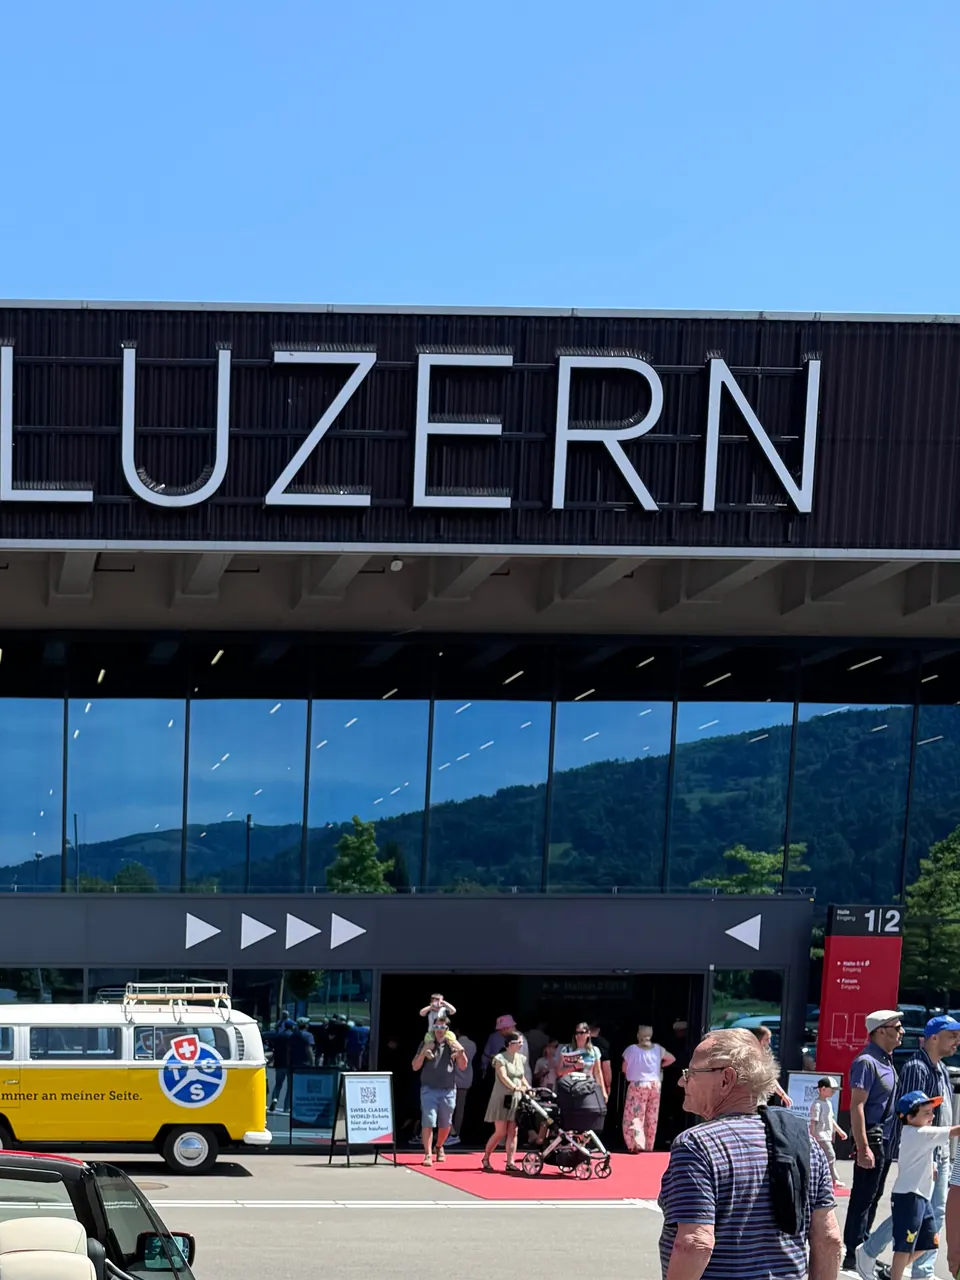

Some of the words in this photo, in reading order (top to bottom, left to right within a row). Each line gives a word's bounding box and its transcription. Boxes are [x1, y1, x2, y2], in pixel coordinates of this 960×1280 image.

[41, 1092, 58, 1101] an
[60, 1090, 106, 1101] meiner
[109, 1090, 143, 1101] Seite.
